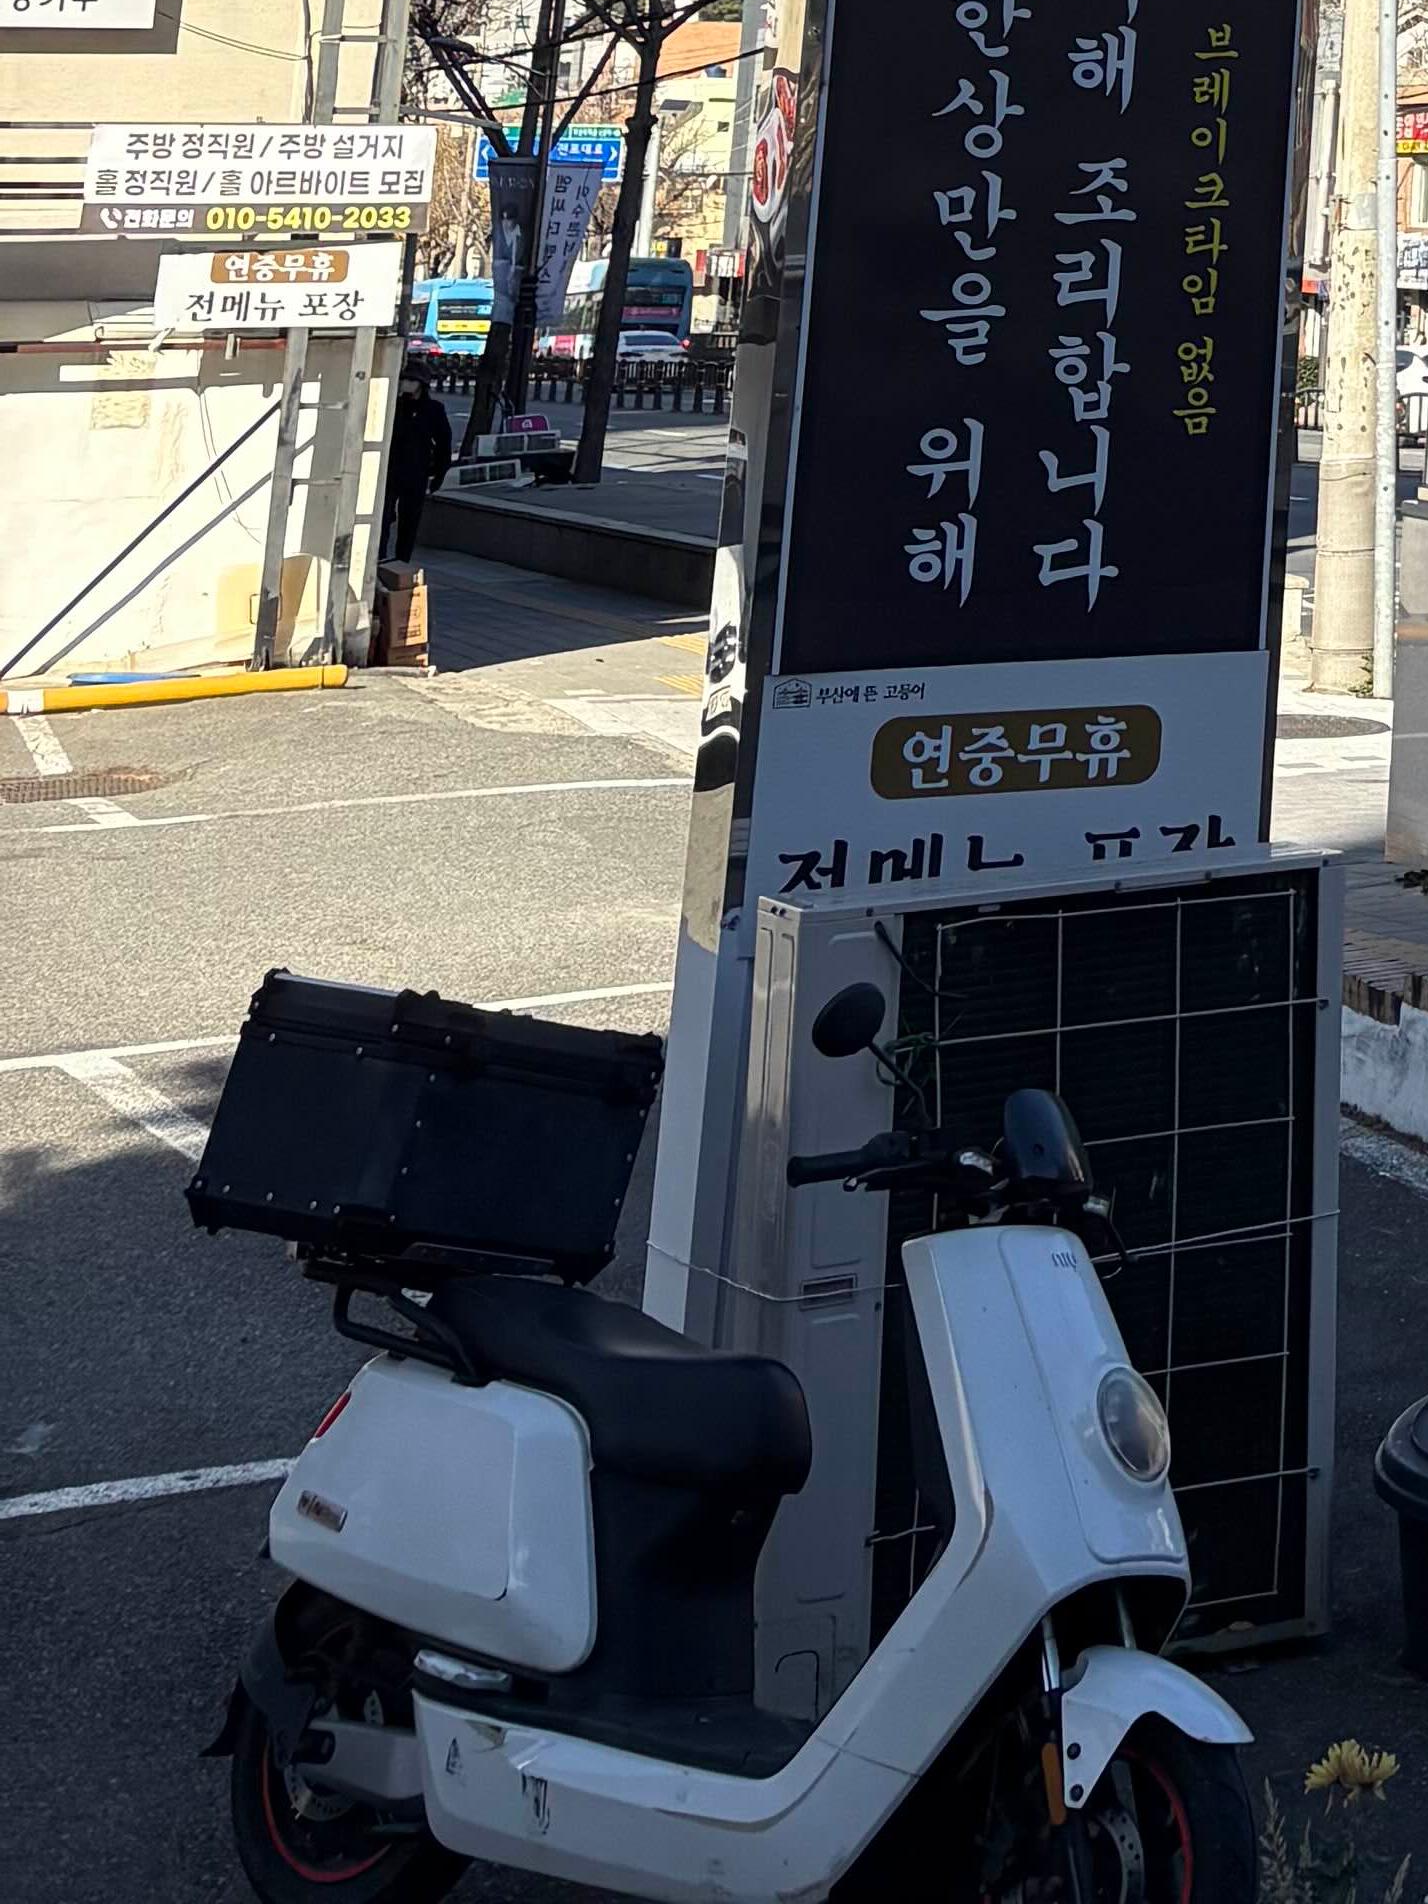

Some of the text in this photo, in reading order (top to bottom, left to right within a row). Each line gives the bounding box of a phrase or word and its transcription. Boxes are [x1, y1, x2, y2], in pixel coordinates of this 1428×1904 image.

[126, 132, 176, 160] 주방
[182, 132, 254, 160] 정직원
[278, 132, 327, 160] 주방
[332, 133, 403, 160] 설거지
[95, 168, 119, 197] 홀
[125, 169, 198, 197] 정직원
[219, 168, 243, 197] 홀
[250, 170, 370, 197] 아르바이트
[378, 170, 425, 196] 모집
[1181, 23, 1240, 316] 브레이크타임
[206, 205, 412, 231] 010-5410-2033
[224, 251, 336, 283] 연중무휴
[185, 290, 365, 323] 전메뉴 포장
[1032, 156, 1137, 614] 조리합니다
[1172, 334, 1218, 436] 없음
[904, 417, 986, 609] 위해
[816, 685, 860, 705] 부산에
[902, 714, 1133, 791] 연중무휴
